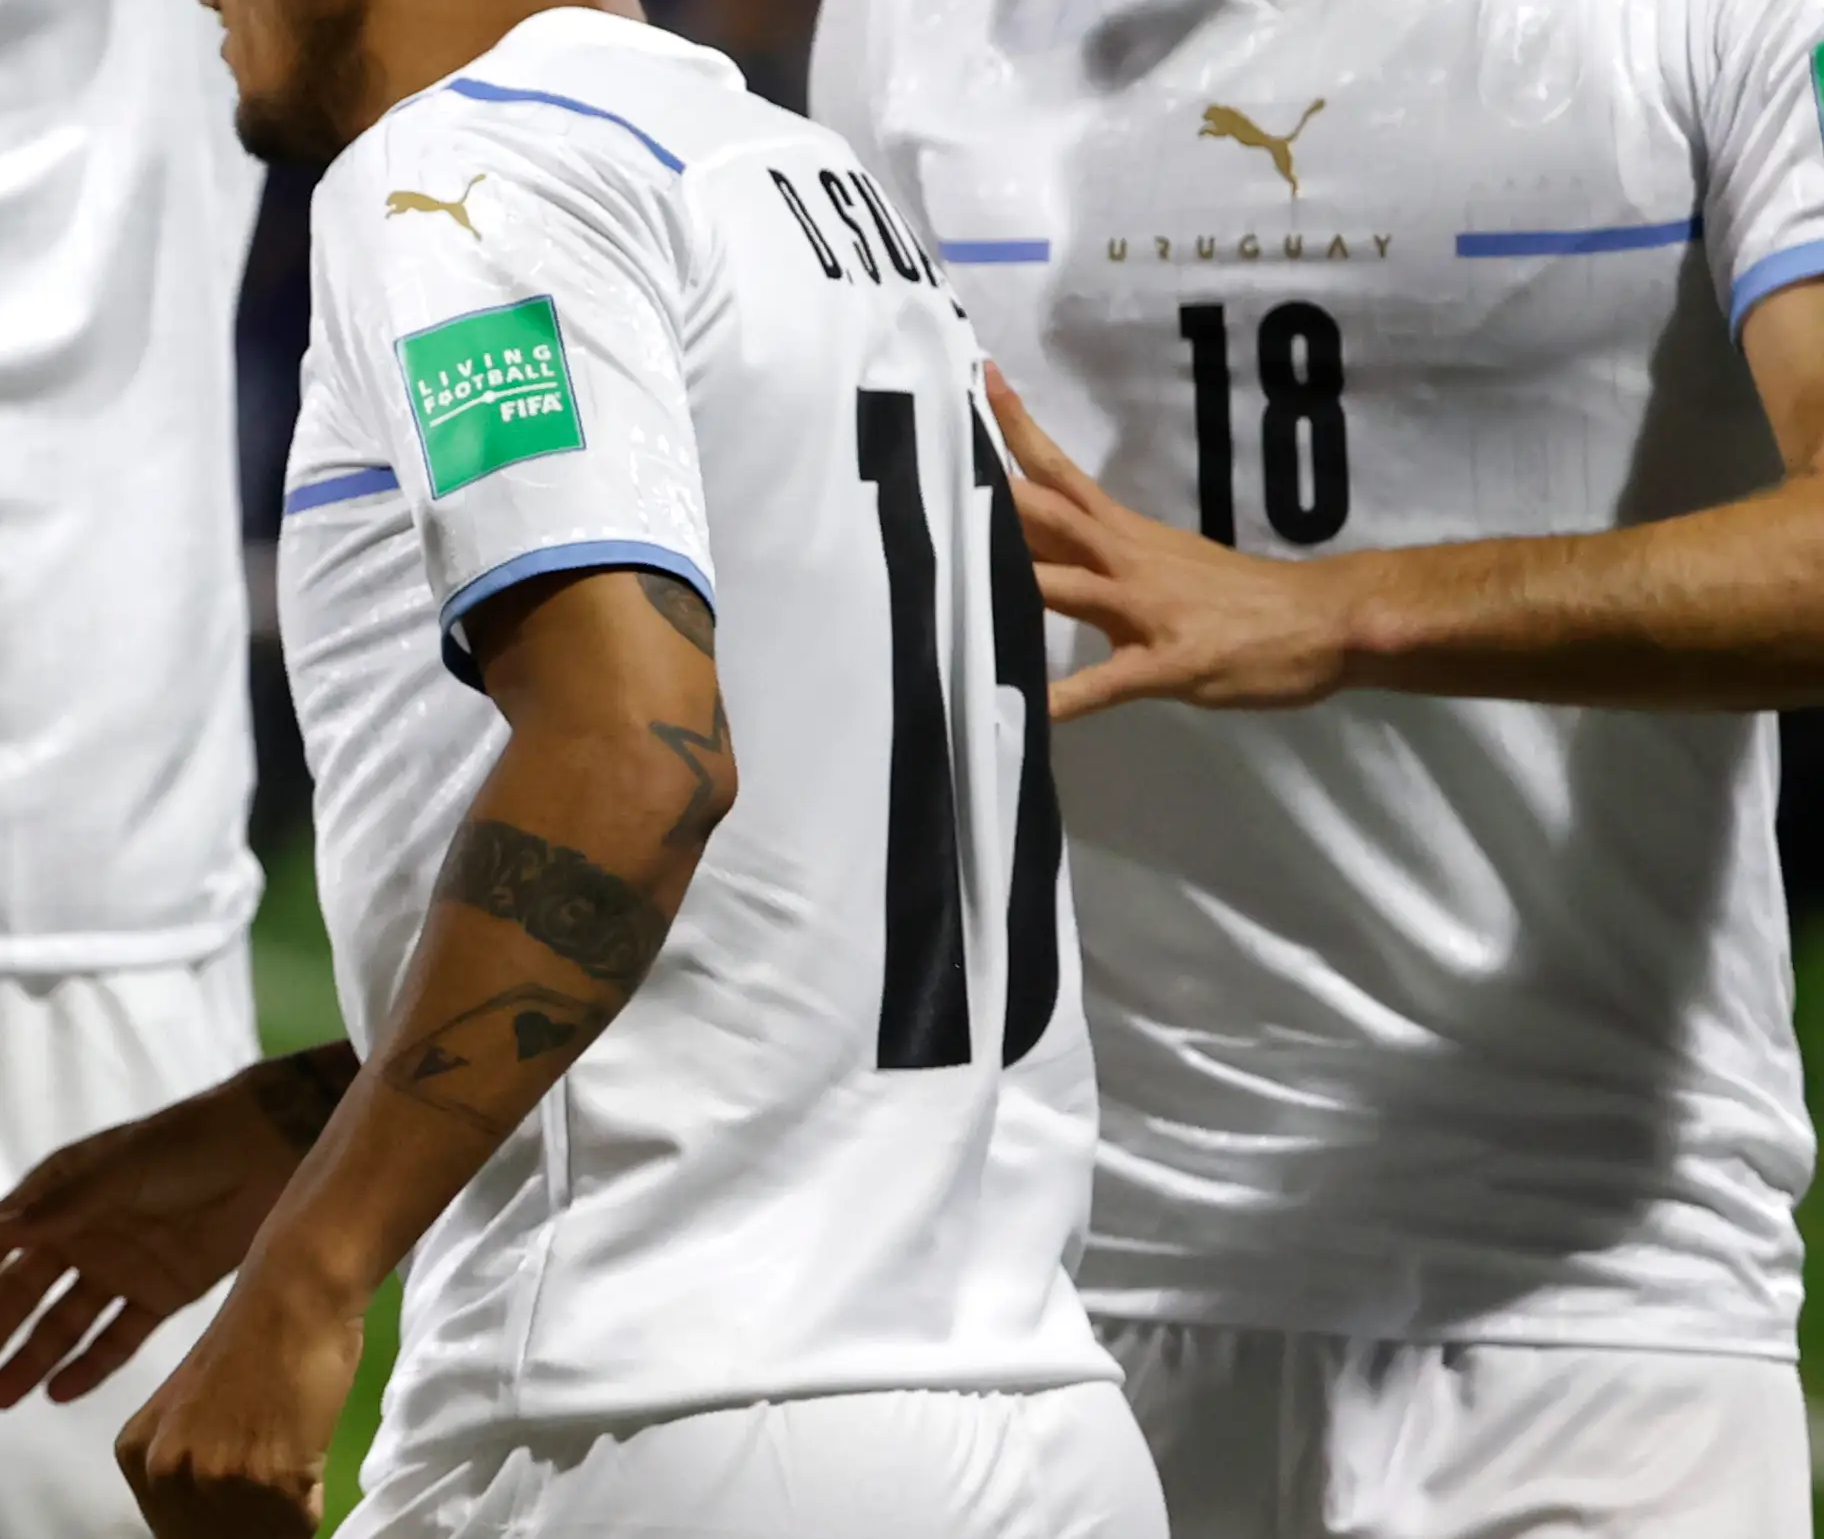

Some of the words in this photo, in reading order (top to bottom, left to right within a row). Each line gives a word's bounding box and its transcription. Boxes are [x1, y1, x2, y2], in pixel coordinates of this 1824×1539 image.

[1108, 233, 1392, 262] URUGUAY
[417, 343, 552, 398] LIVING
[422, 361, 556, 415] FOOTBALL
[500, 391, 563, 423] FIFA
[1178, 300, 1350, 549] 18
